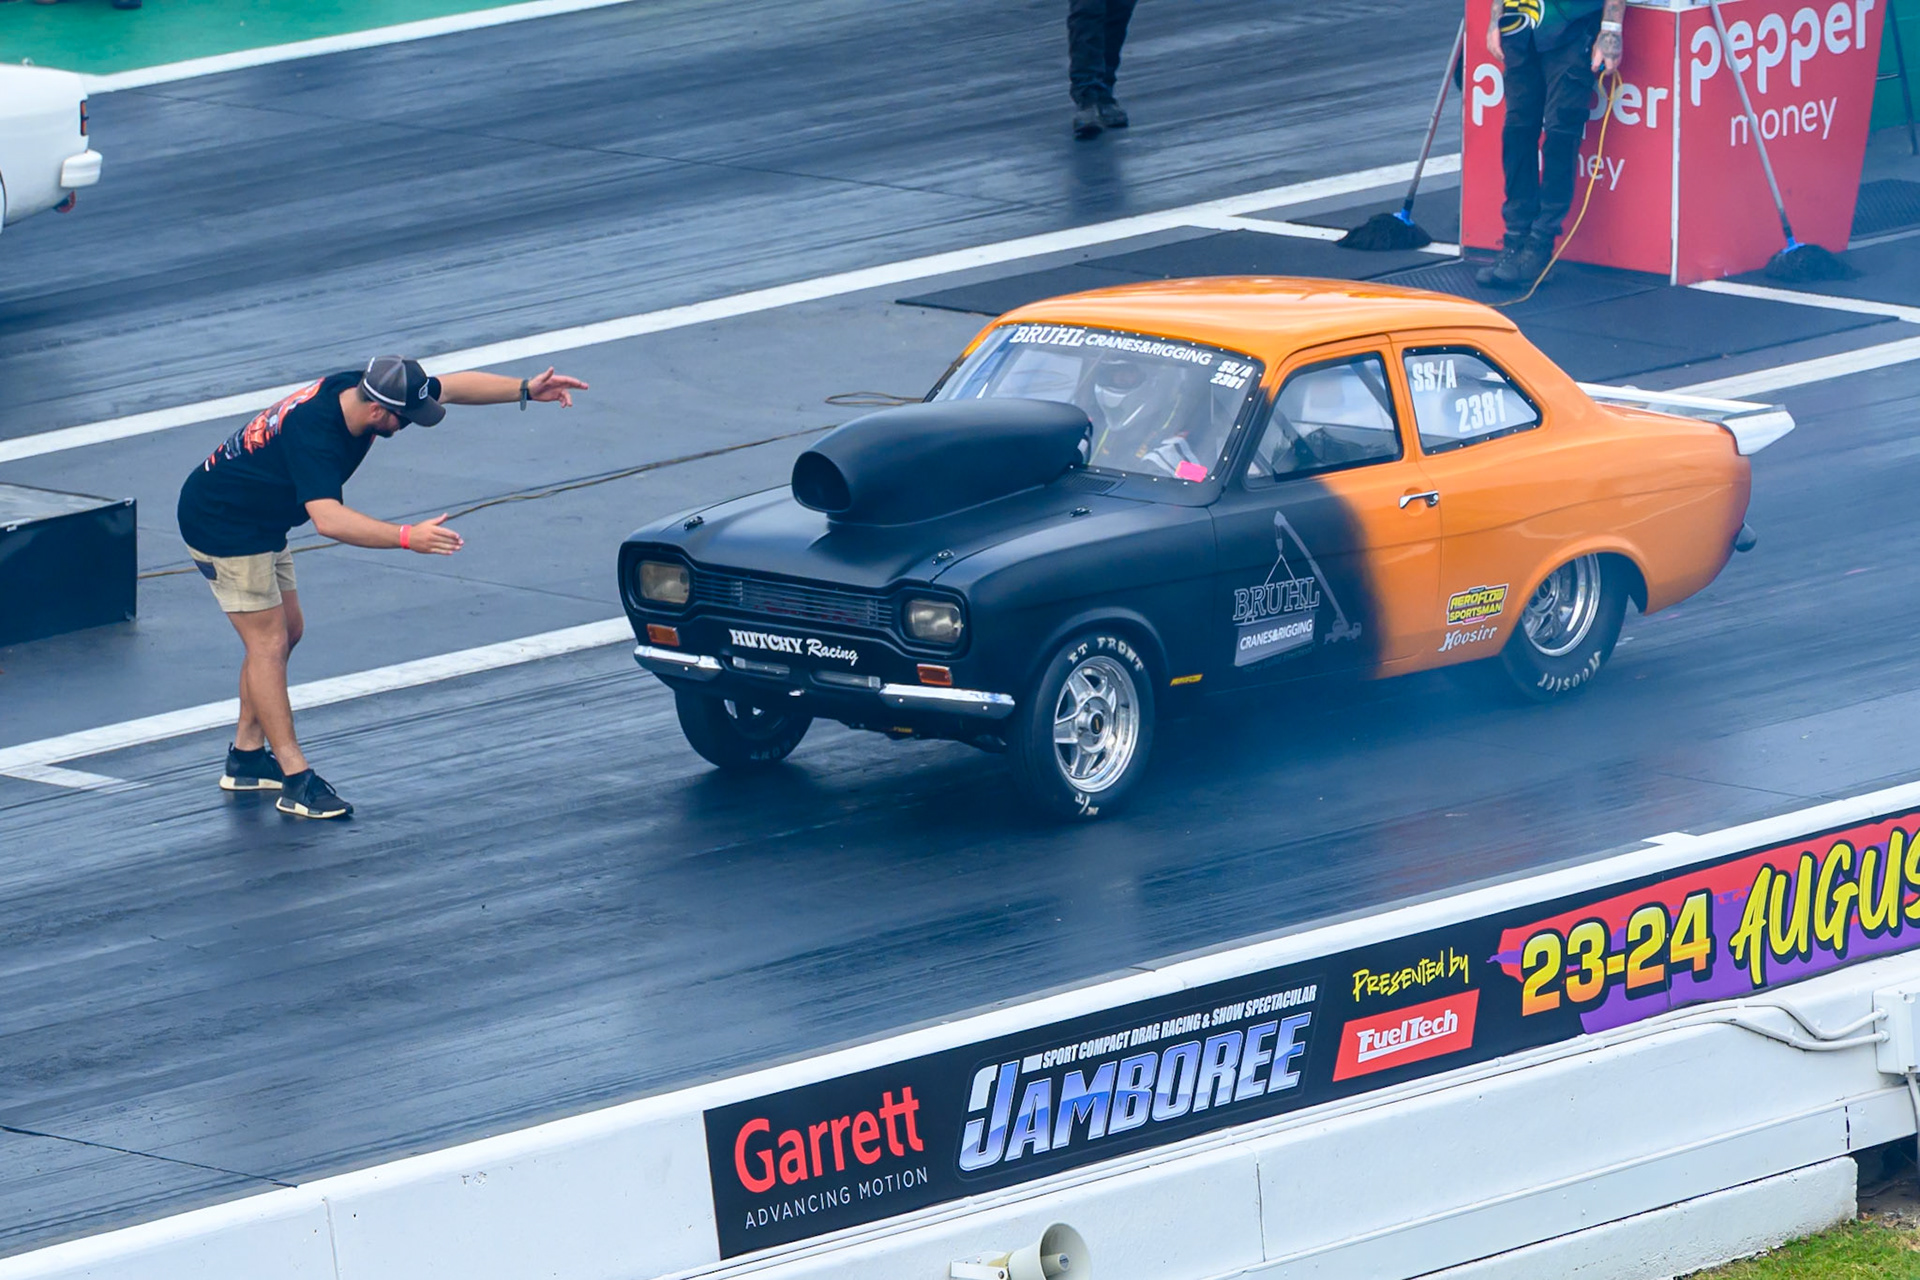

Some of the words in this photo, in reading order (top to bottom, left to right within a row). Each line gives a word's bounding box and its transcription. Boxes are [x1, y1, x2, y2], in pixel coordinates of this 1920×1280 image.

[1690, 0, 1875, 107] pepper
[1472, 63, 1669, 140] per
[1730, 97, 1838, 147] money
[1009, 326, 1086, 347] BRUHL
[1085, 333, 1213, 365] CRANES&RIGGING
[1217, 360, 1253, 378] SS/A
[1412, 359, 1457, 393] SS/A
[1455, 388, 1506, 433] 2381
[1232, 577, 1320, 621] BRUHL
[1449, 602, 1502, 621] SPORTSMAN
[1450, 588, 1505, 610] AEROFLOW
[729, 628, 803, 654] HUTCHY
[806, 638, 859, 667] Racing
[1067, 643, 1088, 665] ET
[1097, 637, 1144, 672] FRONT
[1240, 619, 1313, 650] CRANES&RIGGING
[1448, 947, 1469, 984] by
[1522, 892, 1711, 1017] 23-24
[1042, 1047, 1079, 1069] SPORT
[1078, 1031, 1131, 1060] COMPACT
[1130, 1023, 1160, 1046] DRAG
[1161, 1013, 1202, 1039] RACING
[1201, 1013, 1210, 1028] &
[1211, 1002, 1246, 1027] SHOW
[1244, 985, 1318, 1018] SPECTACULAR
[1356, 1009, 1459, 1054] FuelTech
[958, 1011, 1313, 1173] JAMBOREE
[734, 1086, 925, 1194] Garrett
[745, 1186, 851, 1230] ADVANCING
[858, 1166, 928, 1200] MOTION
